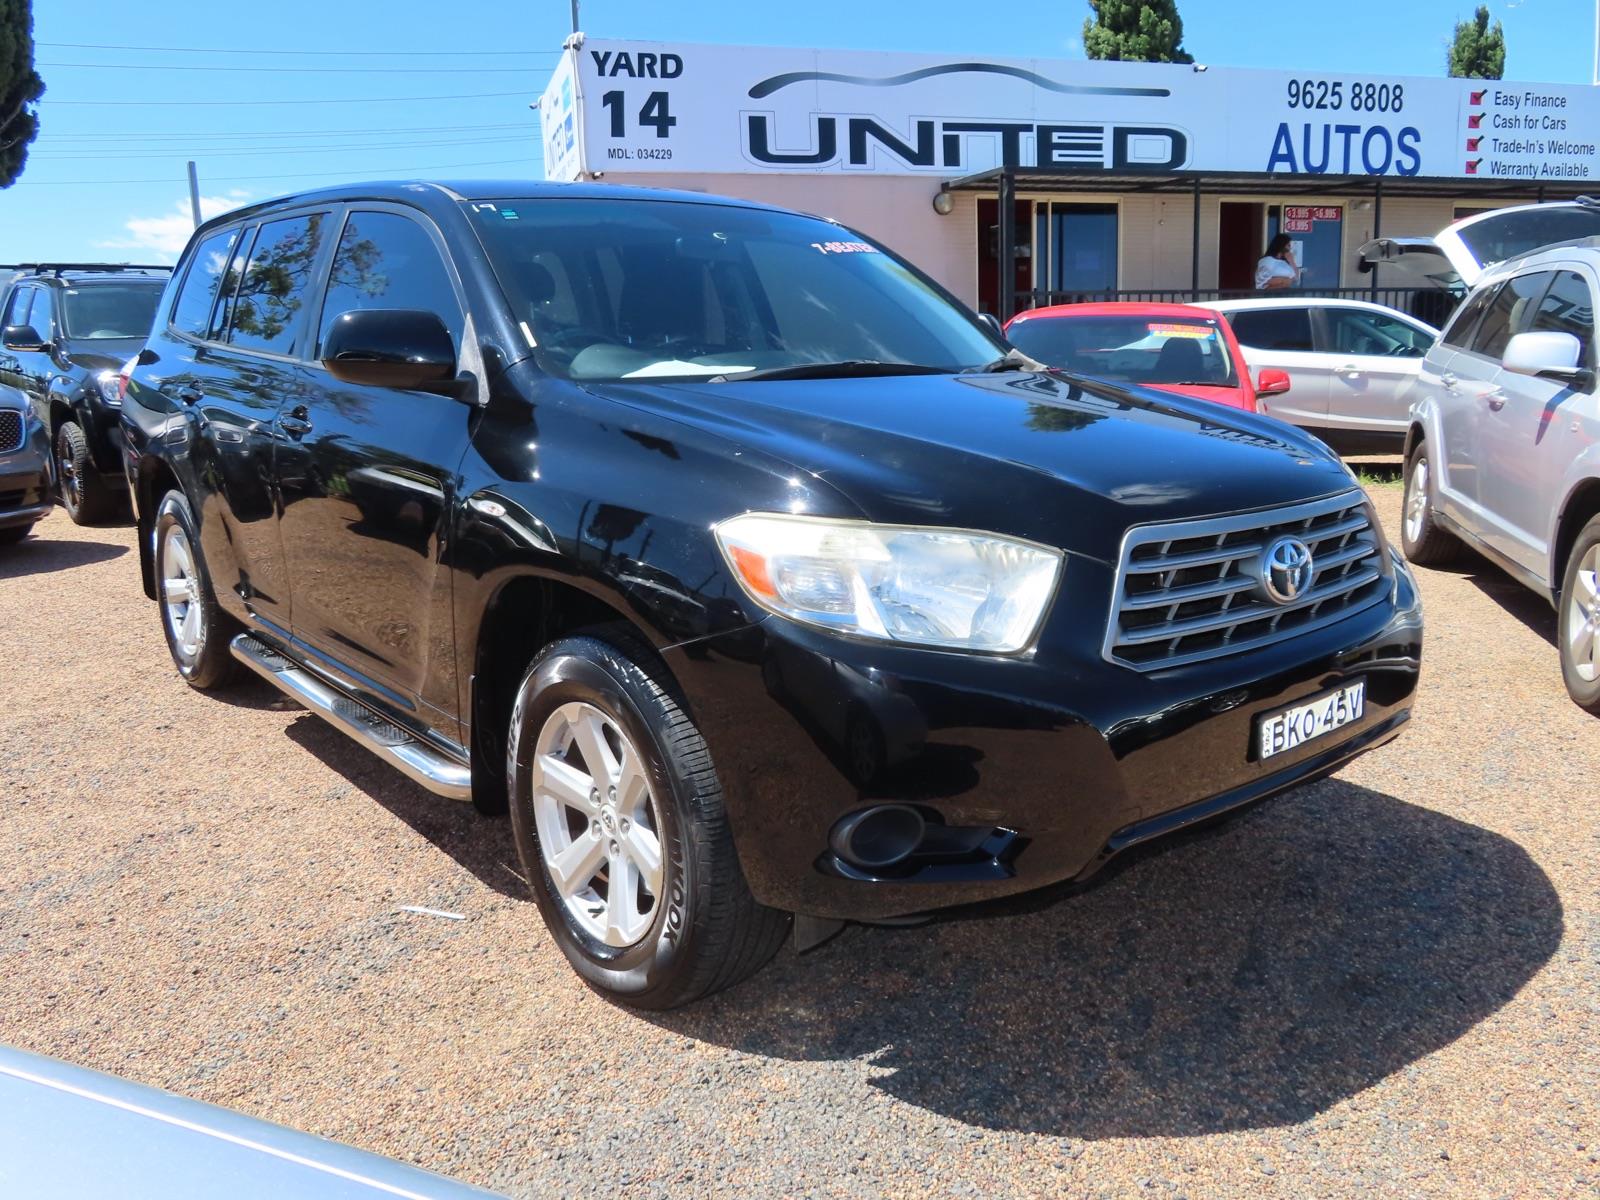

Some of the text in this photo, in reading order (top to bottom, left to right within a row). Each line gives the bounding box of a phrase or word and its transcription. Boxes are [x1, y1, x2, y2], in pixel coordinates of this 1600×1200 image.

[590, 50, 684, 79] YARD
[1287, 79, 1404, 113] 9625 8808
[1494, 91, 1567, 110] Easy Finance
[602, 90, 677, 138] 14
[1493, 113, 1567, 130] Cash for Cars
[608, 148, 673, 160] MDL: 034229
[748, 115, 1188, 169] UNITED
[1266, 122, 1421, 176] AUTOS
[1547, 140, 1595, 155] Welcome
[1490, 161, 1589, 179] Warranty Available
